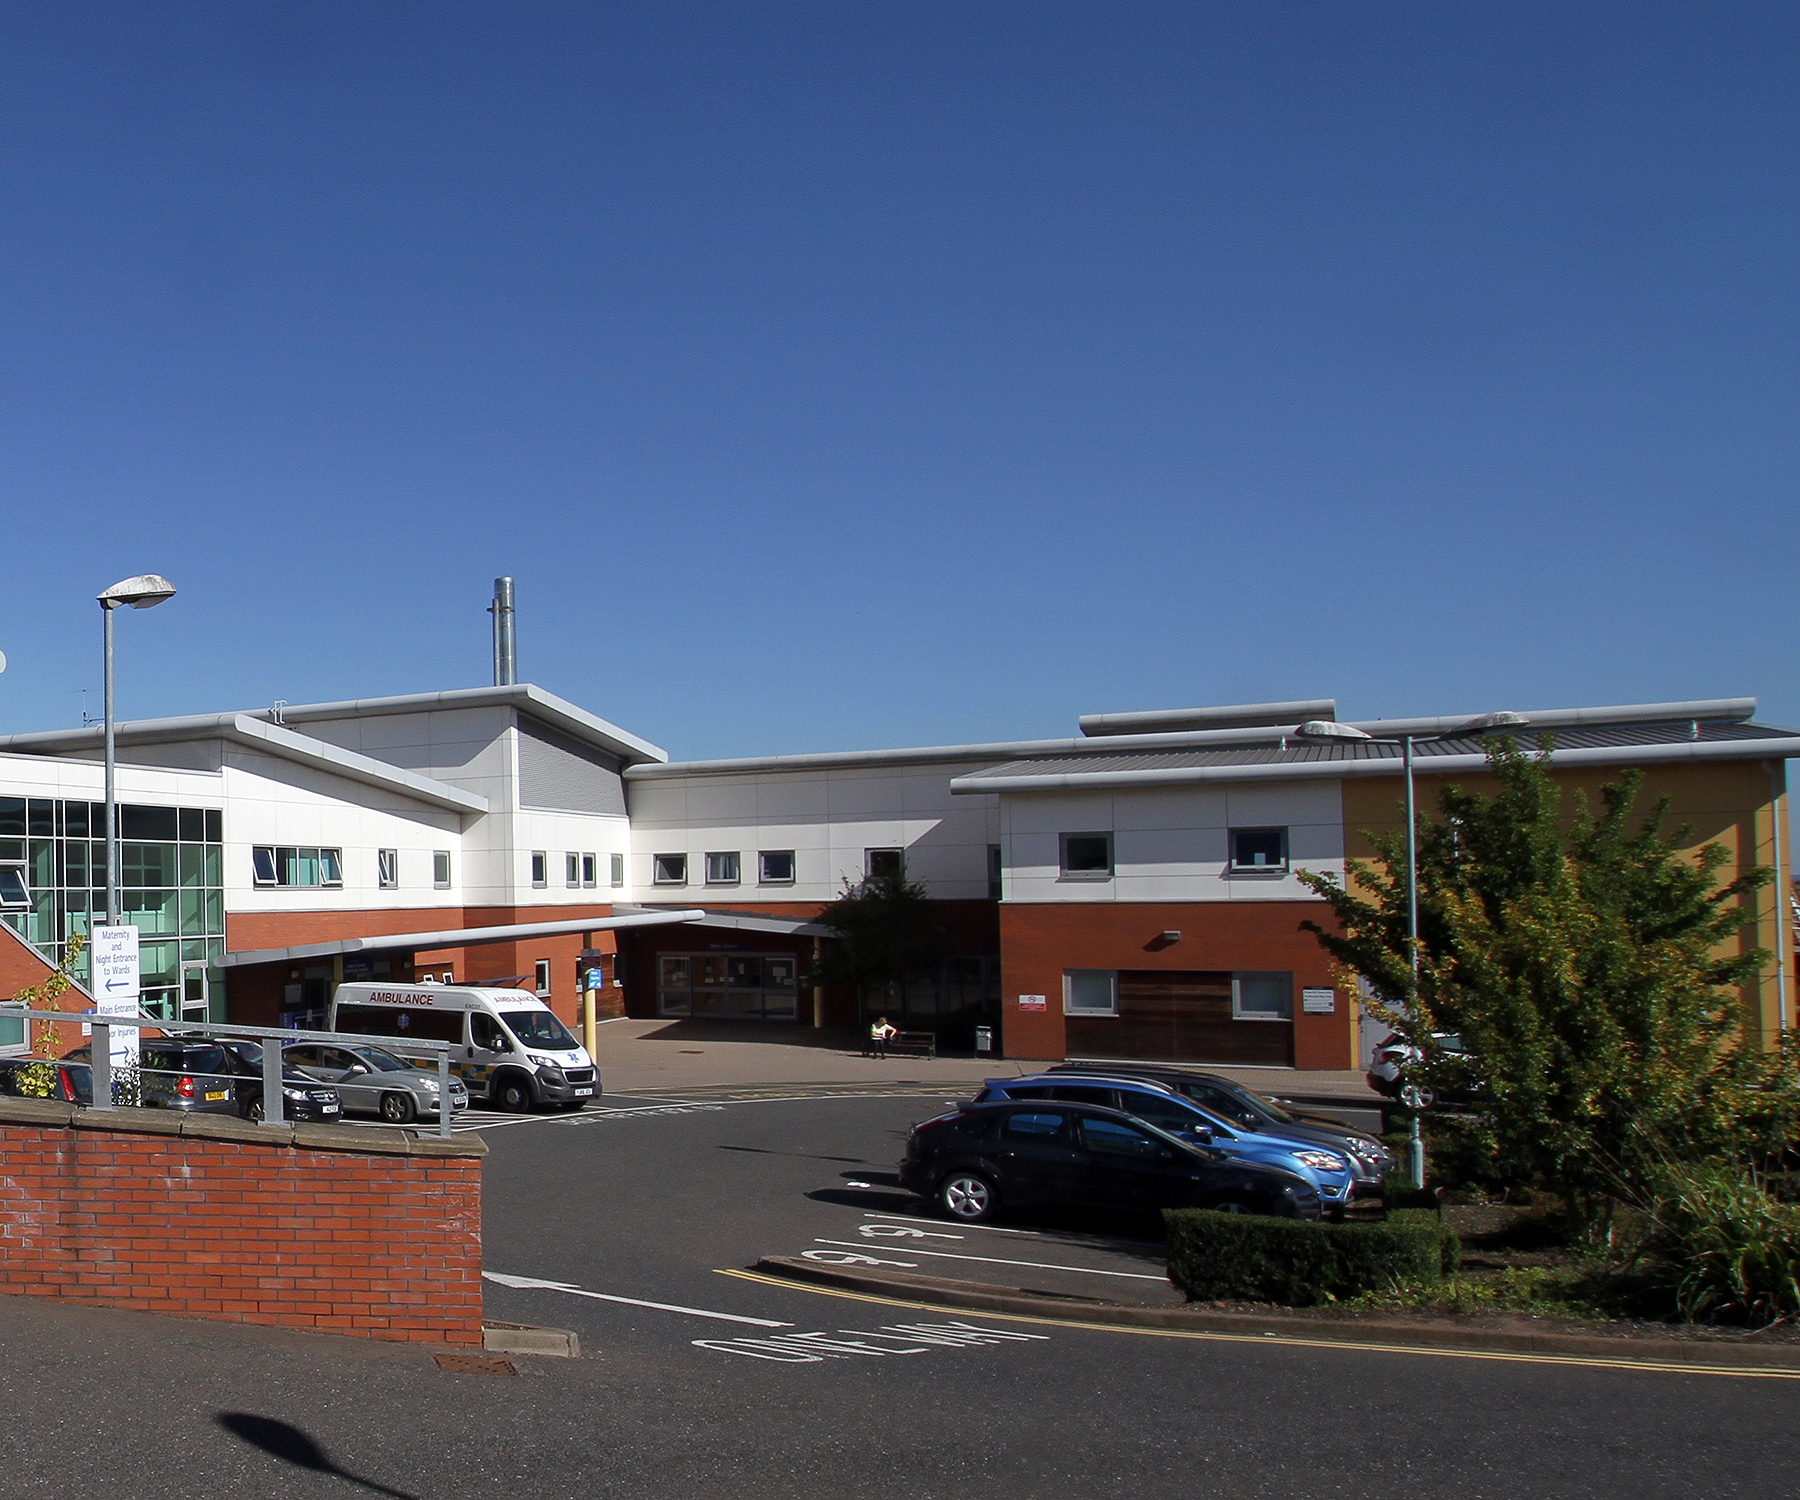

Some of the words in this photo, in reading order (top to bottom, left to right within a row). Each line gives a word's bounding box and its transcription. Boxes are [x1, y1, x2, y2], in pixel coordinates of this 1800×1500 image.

[102, 929, 131, 941] Maternity
[111, 941, 122, 951] and
[95, 954, 112, 967] Night
[112, 953, 137, 964] Entrance
[103, 967, 111, 976] to
[112, 965, 131, 975] Wards
[369, 992, 434, 1006] AMBULANCE
[493, 996, 538, 1004] AMBULANCE
[100, 1005, 113, 1015] Main
[114, 1003, 137, 1013] Entrance
[117, 1026, 137, 1039] Injuries
[691, 1331, 929, 1363] ONE
[837, 1320, 1051, 1347] WAY
